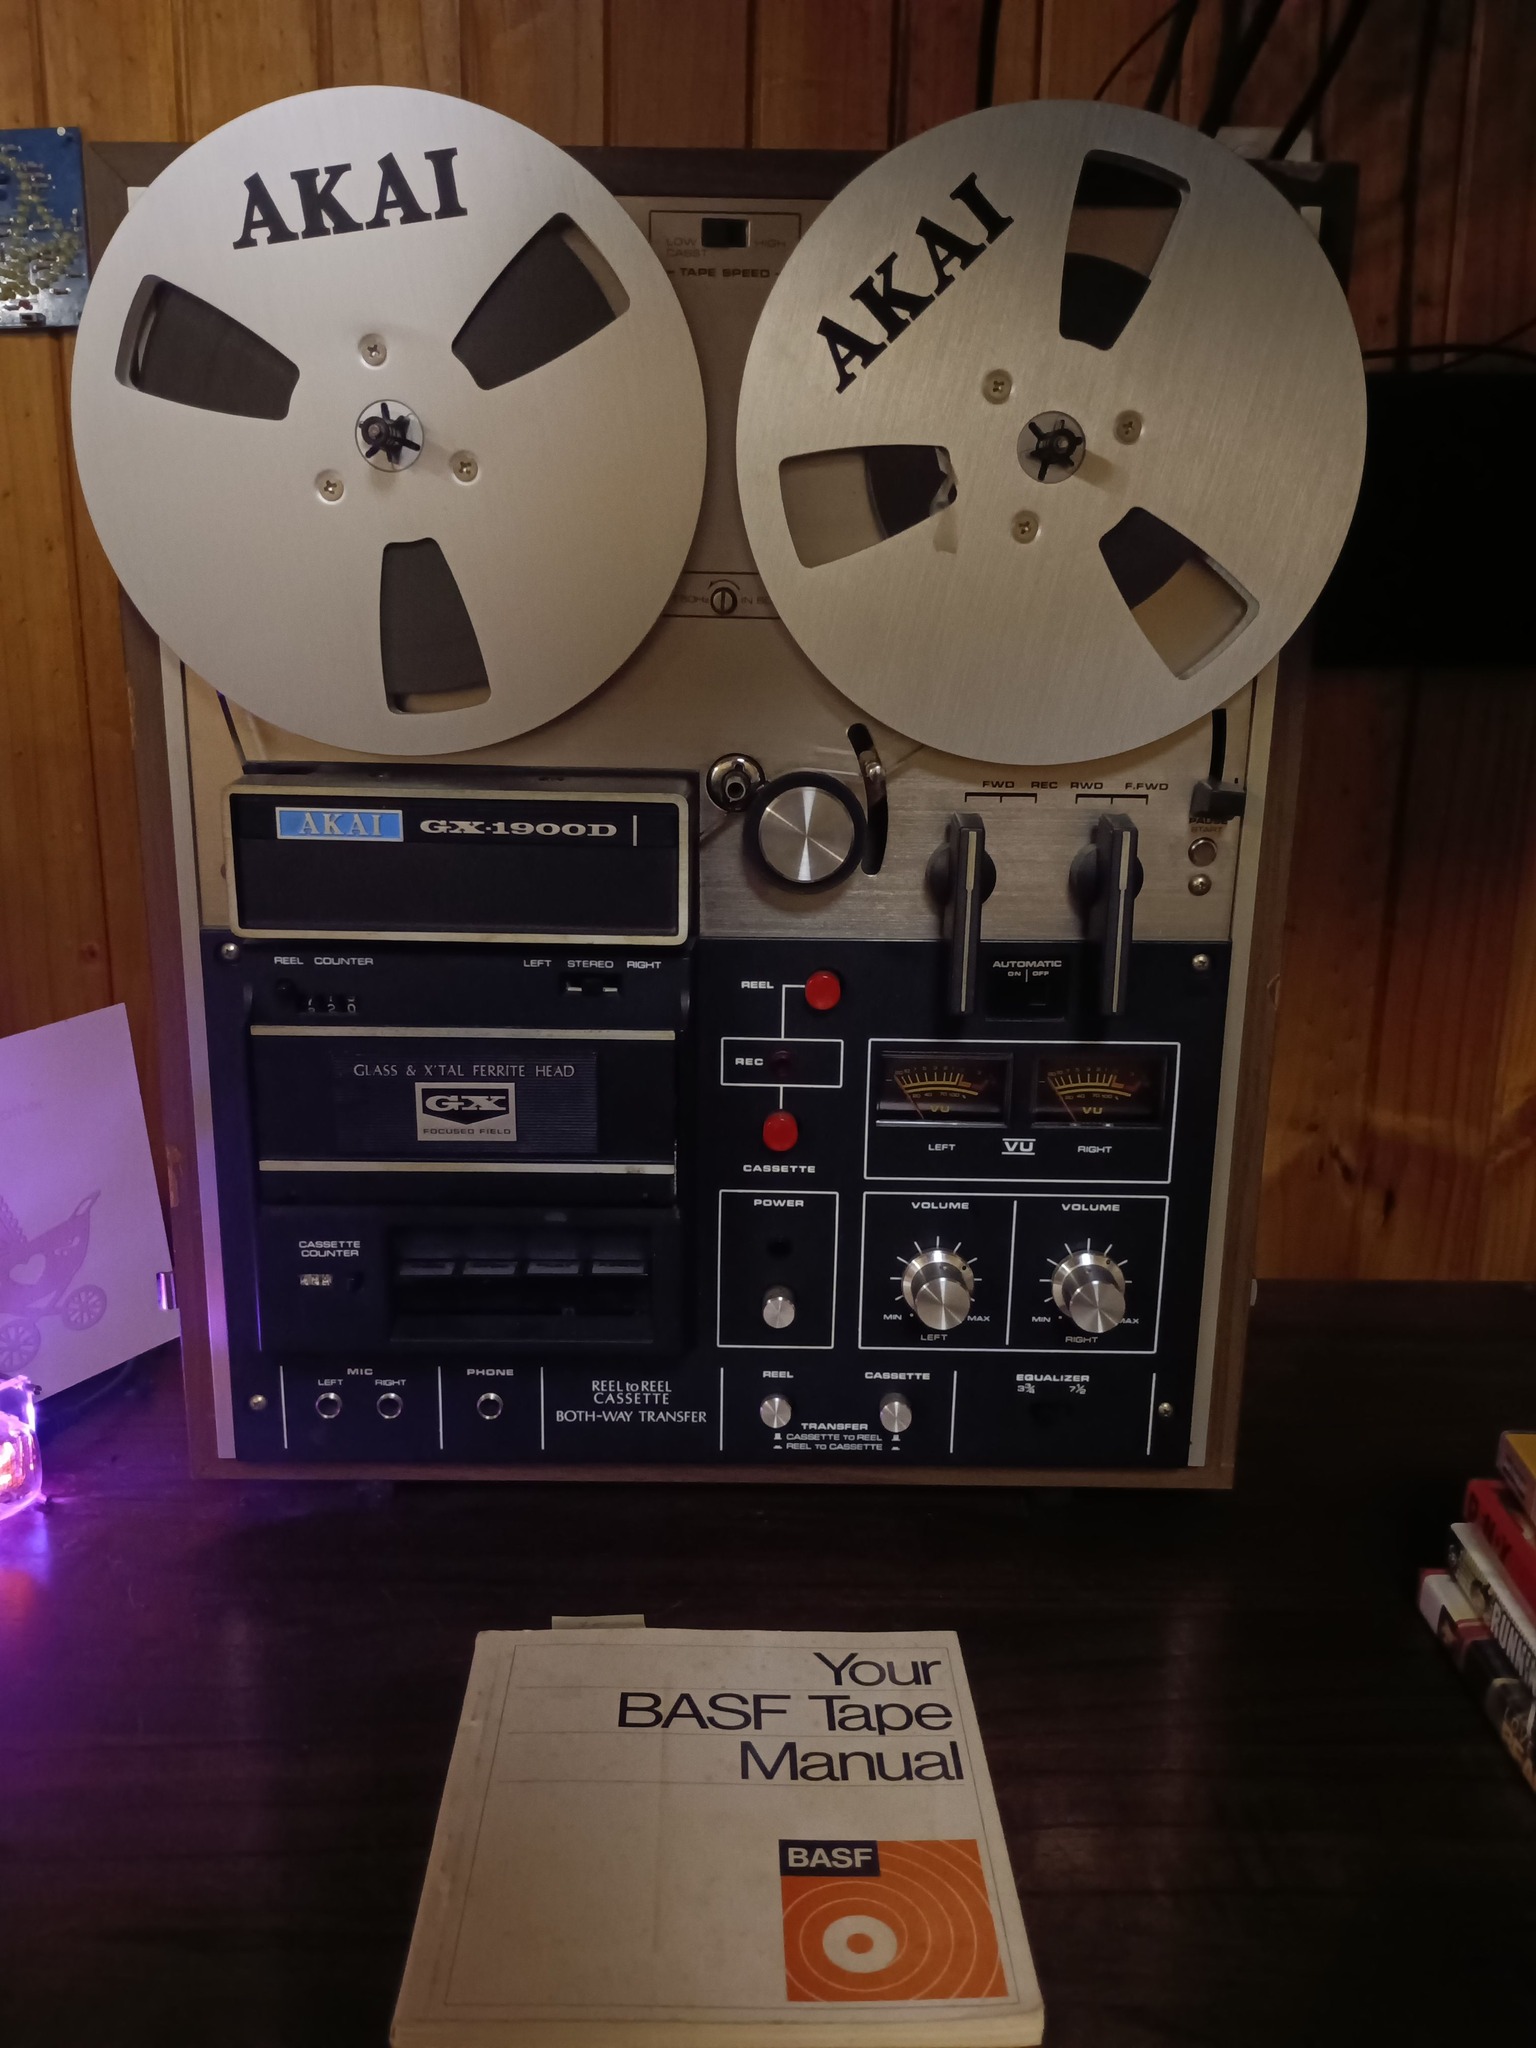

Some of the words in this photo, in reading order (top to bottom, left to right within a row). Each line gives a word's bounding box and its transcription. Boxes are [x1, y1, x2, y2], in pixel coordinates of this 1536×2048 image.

[233, 147, 468, 249] AKAI
[680, 267, 717, 277] TAPE
[722, 268, 770, 278] SPEED
[817, 172, 1014, 394] AKAI
[982, 780, 1015, 789] FWD
[1031, 781, 1058, 790] REC
[1070, 781, 1104, 790] RWD
[1124, 782, 1169, 792] F.FWD
[300, 811, 382, 838] AKAI
[419, 818, 618, 838] GX-1900D
[274, 956, 304, 966] REEL
[313, 956, 374, 967] COUNTER
[523, 959, 552, 968] LEFT
[567, 960, 614, 969] STEREO
[626, 961, 662, 970] RIGHT
[993, 960, 1062, 968] AUTOMATIC
[741, 980, 774, 989] REEL
[735, 1057, 764, 1066] REC
[353, 1063, 398, 1077] GLASS
[406, 1064, 416, 1076] &
[424, 1064, 465, 1077] X'TAL
[472, 1065, 526, 1077] FERRITE
[535, 1065, 575, 1078] HEAD
[425, 1095, 506, 1112] GX
[930, 1105, 950, 1113] VU
[1082, 1107, 1103, 1115] VU
[1004, 1141, 1034, 1153] VU
[1077, 1146, 1112, 1154] RIGHT
[743, 1164, 816, 1174] CASSETTE
[753, 1199, 805, 1208] POWER
[911, 1201, 970, 1210] VOLUME
[1061, 1203, 1121, 1212] VOLUME
[299, 1241, 361, 1249] CASSETTE
[1065, 1336, 1099, 1344] RIGHT
[762, 1370, 794, 1379] REEL
[864, 1371, 931, 1380] CASSETTE
[1016, 1374, 1090, 1382] EQUALIZER
[592, 1380, 623, 1392] REEL
[626, 1382, 639, 1392] to
[641, 1381, 672, 1392] REEL
[593, 1393, 669, 1405] CASSETTE
[556, 1410, 633, 1422] BOTH-WAY
[638, 1411, 707, 1423] TRANSFER
[801, 1422, 868, 1431] TRANSFER
[786, 1433, 840, 1441] CASSETTE
[786, 1442, 812, 1450] REEL
[829, 1442, 883, 1451] CASSETTE
[813, 1652, 941, 1686] Your
[617, 1692, 791, 1730] BASF
[808, 1694, 952, 1735] Tape
[740, 1741, 964, 1781] Manual
[787, 1847, 873, 1868] BASF
